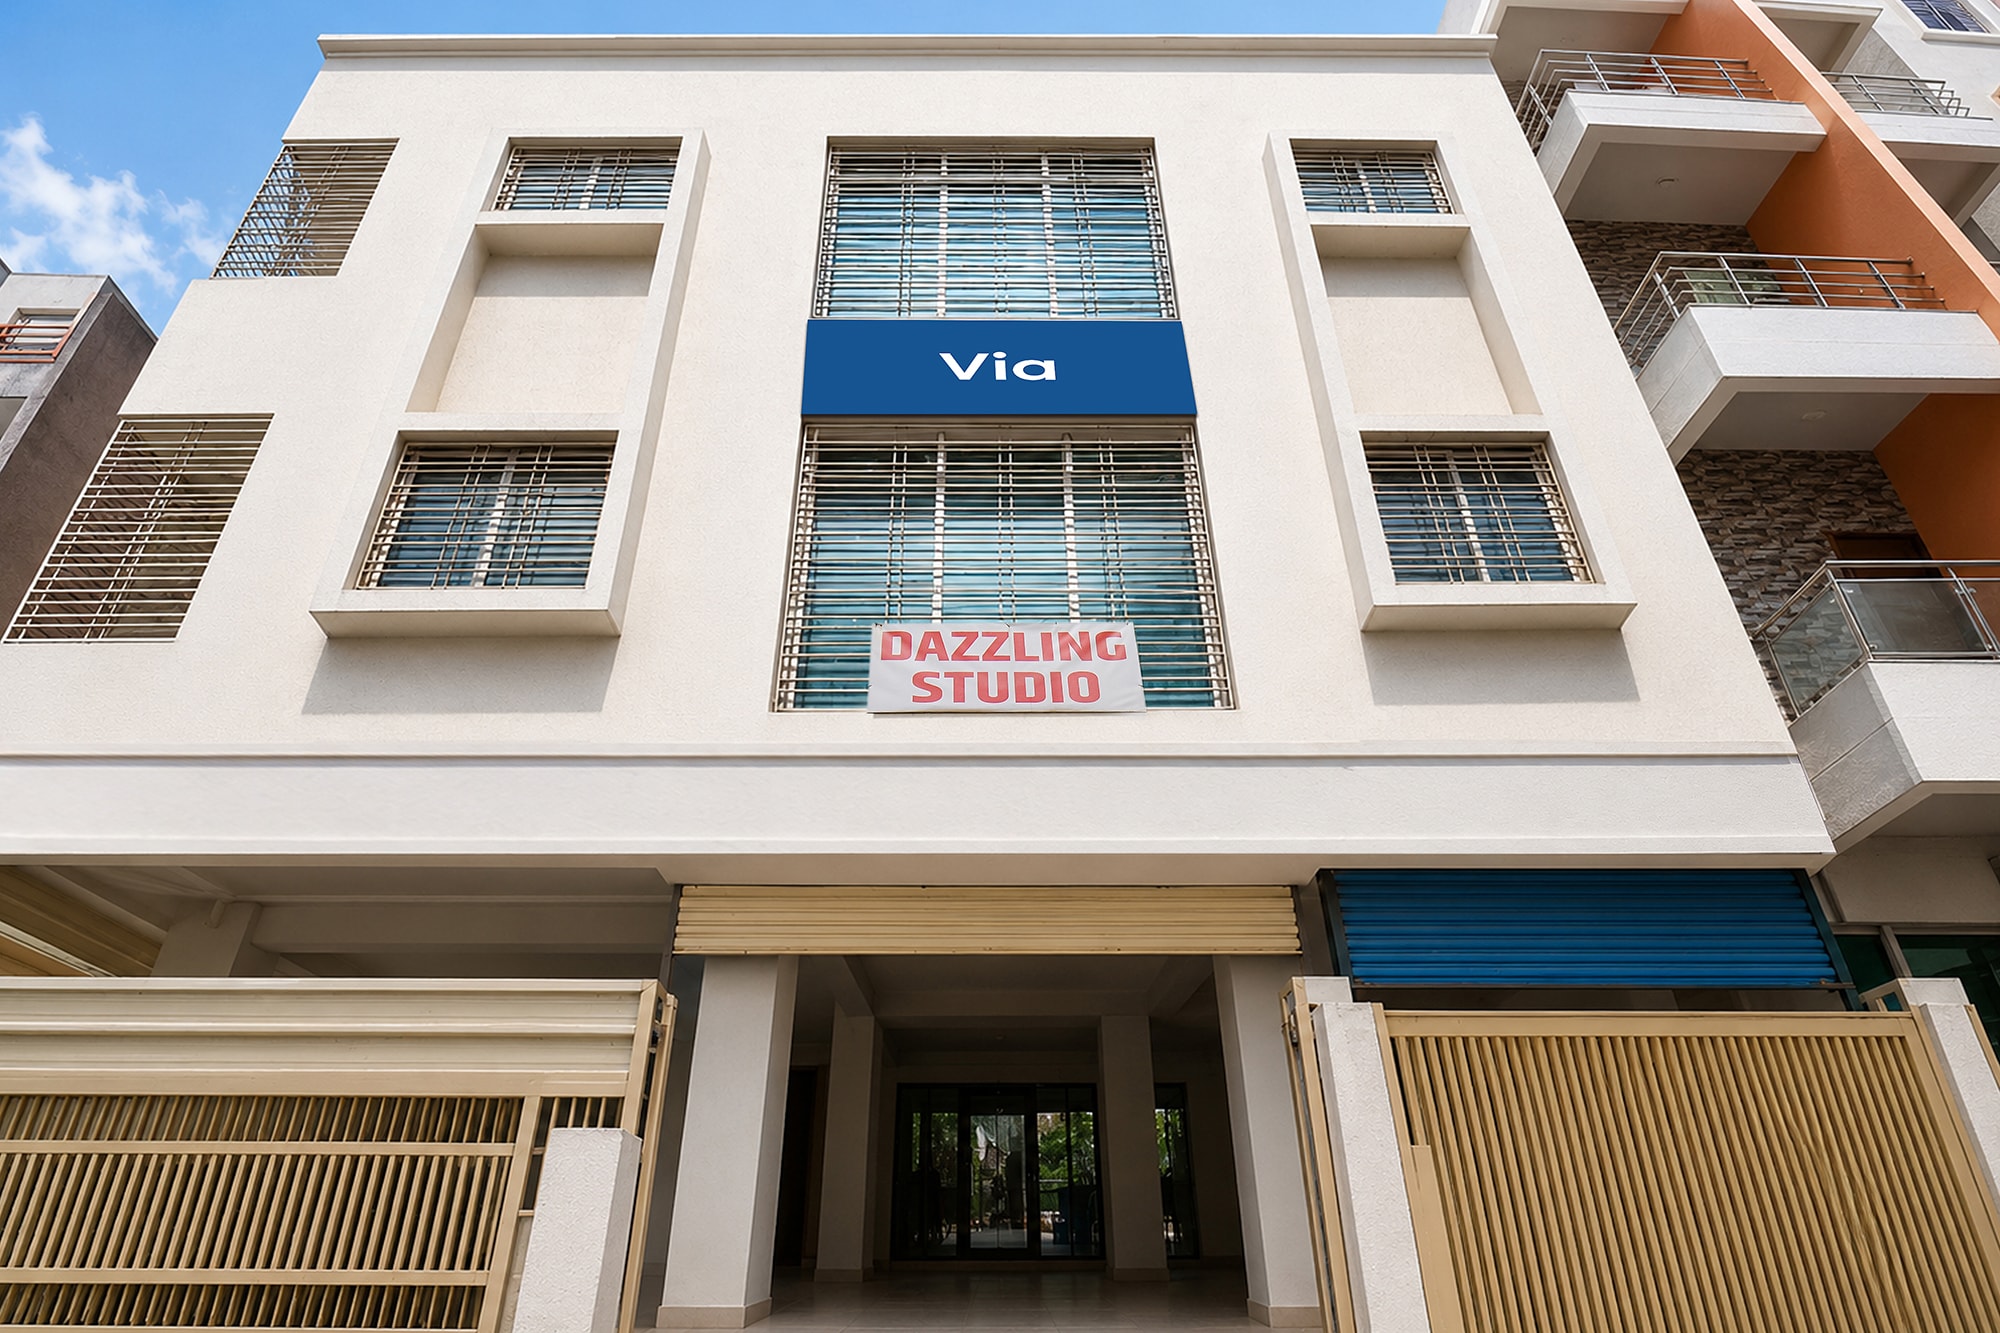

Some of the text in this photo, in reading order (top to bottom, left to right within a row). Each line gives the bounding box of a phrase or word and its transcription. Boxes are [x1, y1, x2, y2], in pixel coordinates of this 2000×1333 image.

[940, 351, 1056, 381] Via
[880, 630, 1127, 662] DAZZLING
[911, 671, 1101, 704] STUDIO
